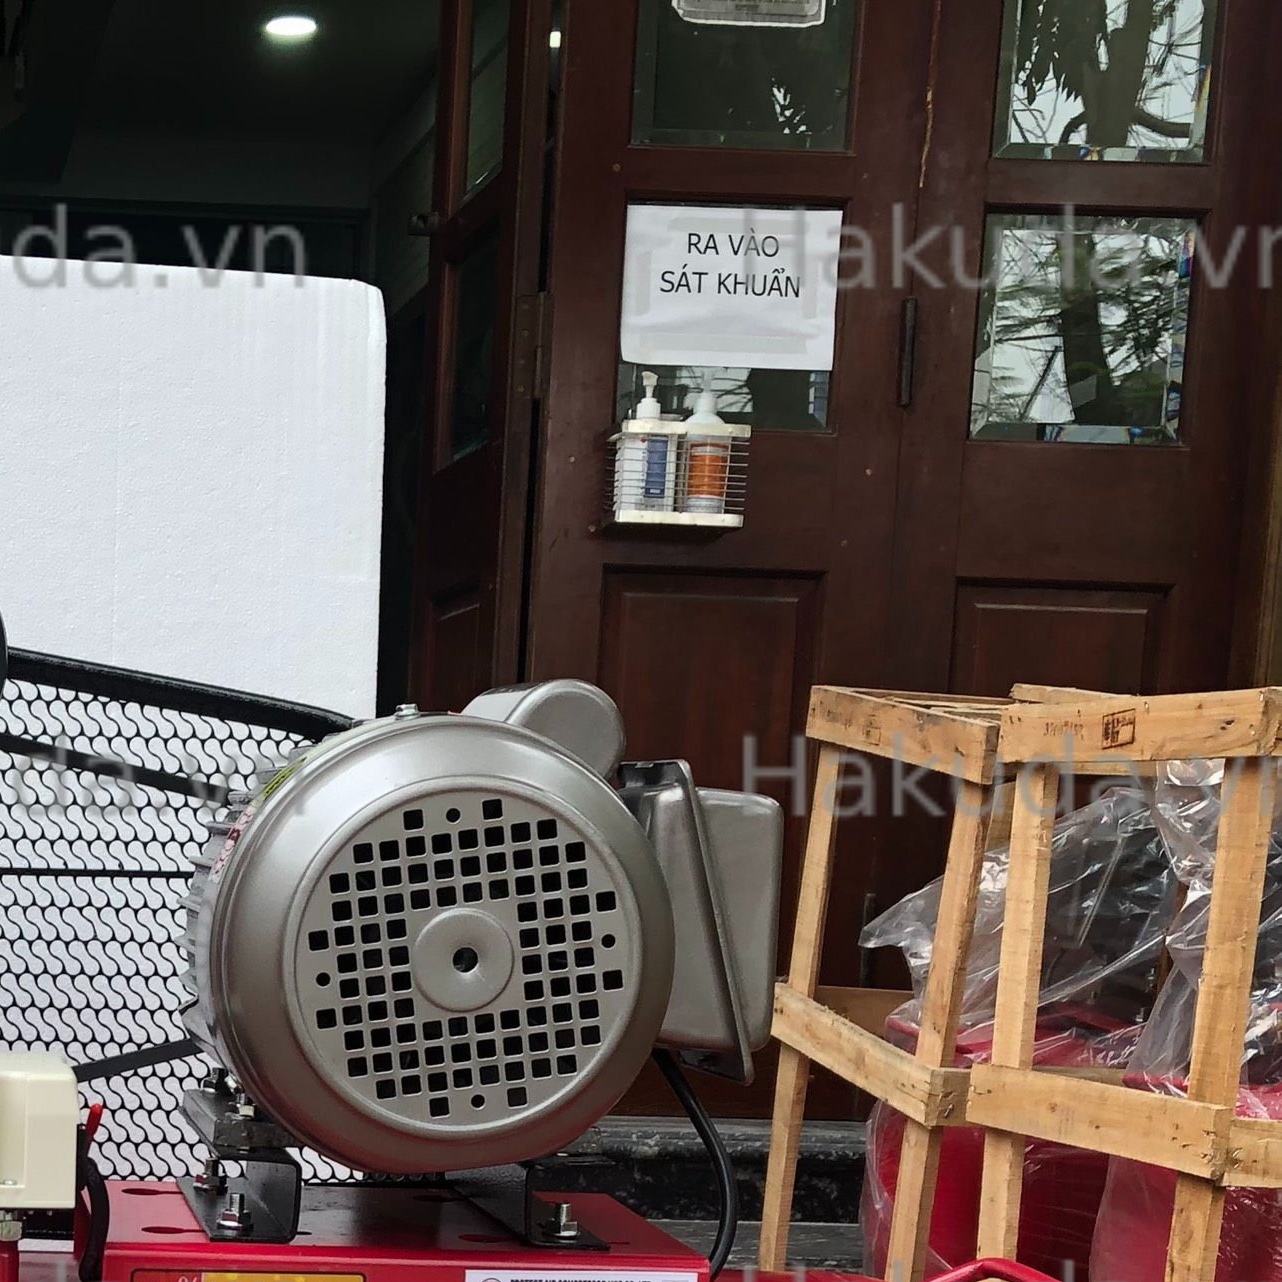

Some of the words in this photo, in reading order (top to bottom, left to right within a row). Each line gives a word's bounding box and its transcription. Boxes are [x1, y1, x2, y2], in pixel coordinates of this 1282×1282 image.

[687, 233, 720, 255] RA
[728, 228, 780, 257] VÀO
[660, 264, 708, 293] SÁT
[717, 267, 801, 298] KHUẨN
